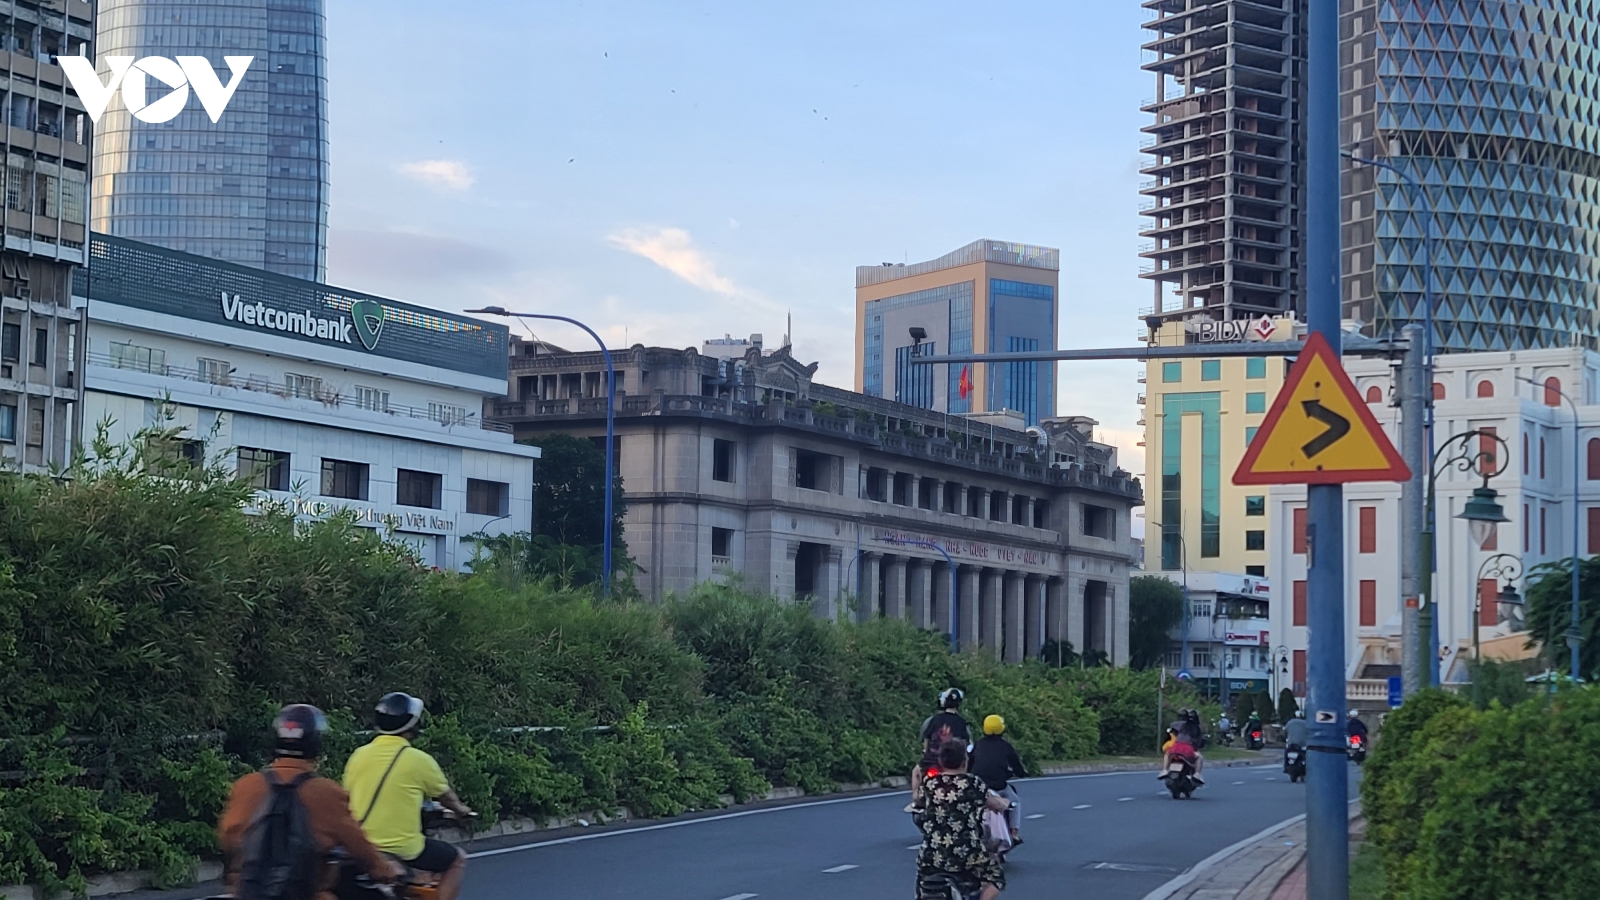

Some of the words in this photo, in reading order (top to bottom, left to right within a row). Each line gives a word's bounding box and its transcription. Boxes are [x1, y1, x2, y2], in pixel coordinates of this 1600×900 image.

[221, 291, 352, 344] Vietcombank
[1199, 320, 1251, 341] BIDV
[406, 511, 427, 530] Việt
[430, 515, 454, 531] Nam
